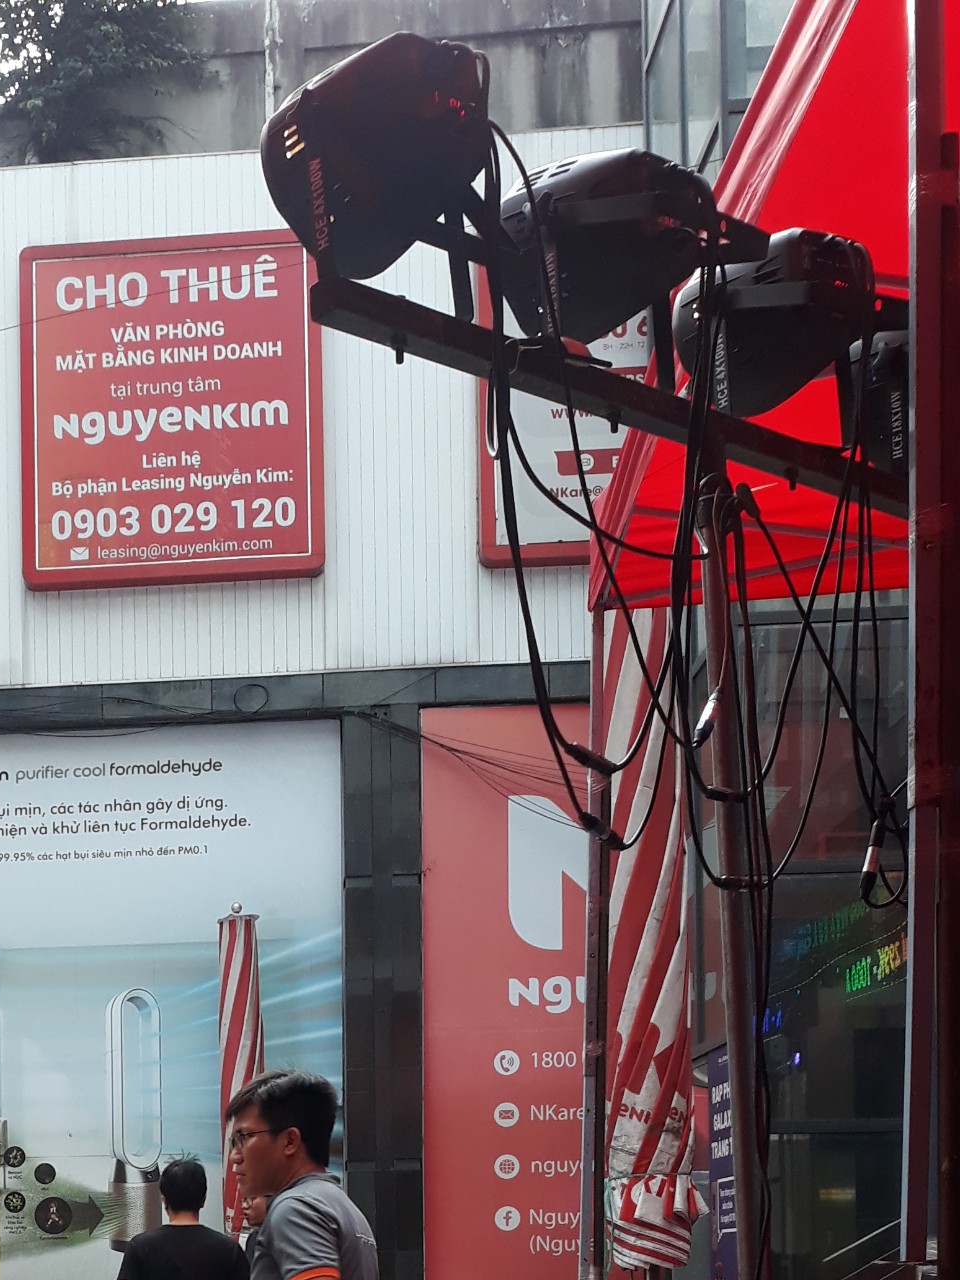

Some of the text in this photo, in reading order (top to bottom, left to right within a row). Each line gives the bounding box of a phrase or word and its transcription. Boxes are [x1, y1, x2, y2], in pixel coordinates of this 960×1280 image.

[55, 253, 279, 313] CHO THUÊ
[110, 319, 225, 344] VĂN PHÒNG
[55, 340, 282, 374] MẶT BẰNG KINH DOANH
[110, 376, 221, 401] tại trung tâm
[717, 380, 729, 409] HCE
[892, 433, 904, 460] HCE
[142, 450, 202, 470] Liên hệ
[51, 467, 294, 499] Bộ phận Leasing Nguyễn Kim:
[51, 496, 297, 541] 0903 029 120
[97, 537, 273, 561] leasing@nguyenkim.com
[15, 763, 70, 784] purifier
[72, 762, 106, 778] cool
[109, 757, 223, 778] formaldehyde
[14, 801, 46, 819] mịn,
[50, 799, 75, 815] các
[77, 798, 100, 815] tác
[103, 797, 142, 814] nhân
[145, 797, 173, 817] gây
[176, 795, 191, 813] dị
[194, 794, 228, 814] ứng.
[30, 820, 49, 835] và
[52, 817, 80, 835] khử
[83, 817, 110, 833] liên
[113, 817, 137, 835] tục
[140, 812, 252, 832] Formaldehyde.
[37, 850, 53, 862] các
[55, 849, 71, 862] hạt
[73, 848, 89, 862] bụi
[91, 847, 111, 860] siêu
[113, 847, 133, 860] mịn
[135, 845, 154, 857] nhỏ
[156, 845, 176, 857] đến
[178, 844, 209, 856] PM0.1
[531, 1051, 578, 1069] 1800
[530, 1105, 585, 1122] NKare
[713, 1112, 732, 1132] GALAX
[531, 1160, 583, 1177] nguy
[529, 1208, 581, 1230] Nguy
